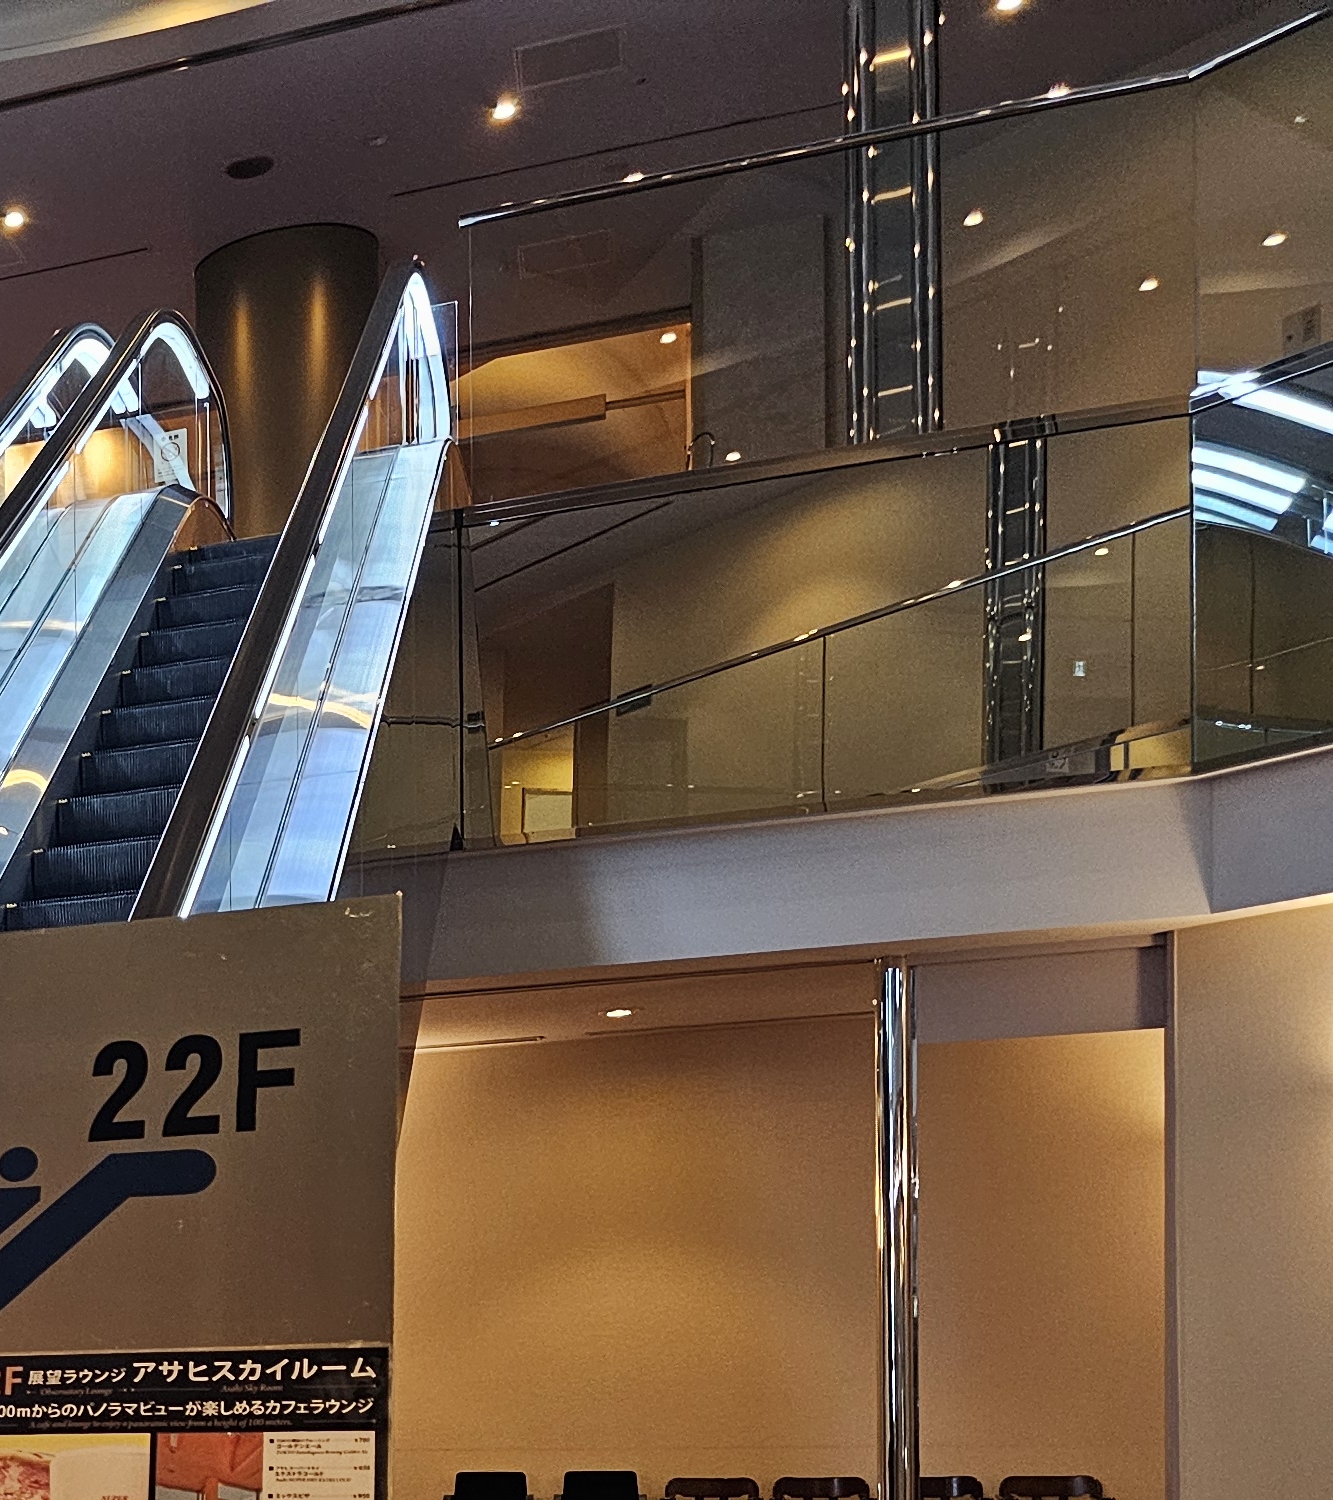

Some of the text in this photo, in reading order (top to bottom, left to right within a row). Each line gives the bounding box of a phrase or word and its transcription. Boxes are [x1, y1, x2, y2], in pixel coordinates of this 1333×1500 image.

[88, 1028, 302, 1141] 22F
[28, 1368, 126, 1385] 展望ラウンジ
[132, 1357, 376, 1382] アサヒスカイルーム
